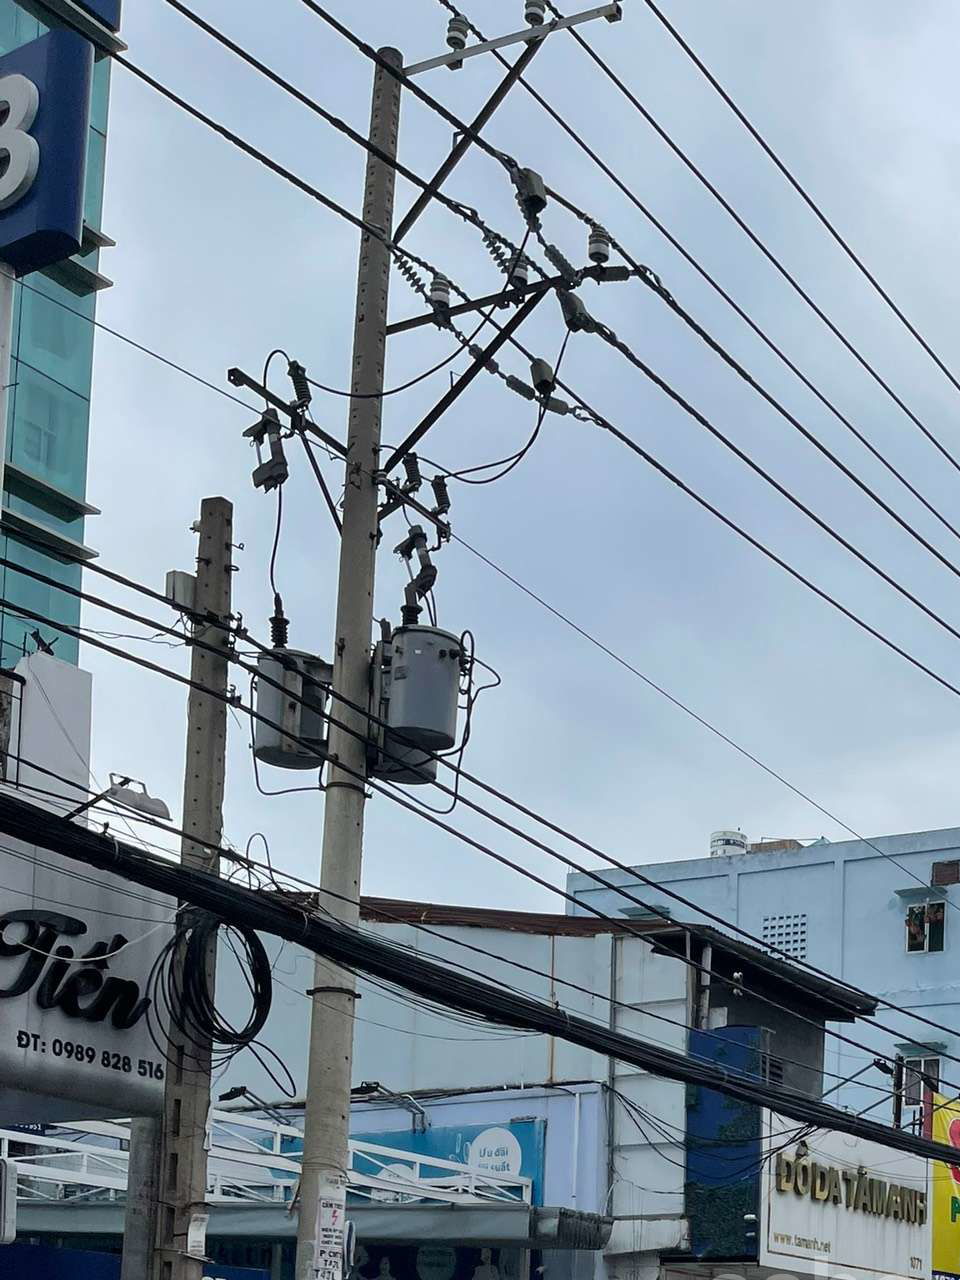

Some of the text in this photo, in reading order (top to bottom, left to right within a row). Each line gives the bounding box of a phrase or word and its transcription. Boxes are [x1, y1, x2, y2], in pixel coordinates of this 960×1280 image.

[17, 1030, 165, 1080] ĐT: 0989 828 516
[887, 1183, 928, 1226] ANH
[773, 1232, 831, 1254] www.tamanh.net
